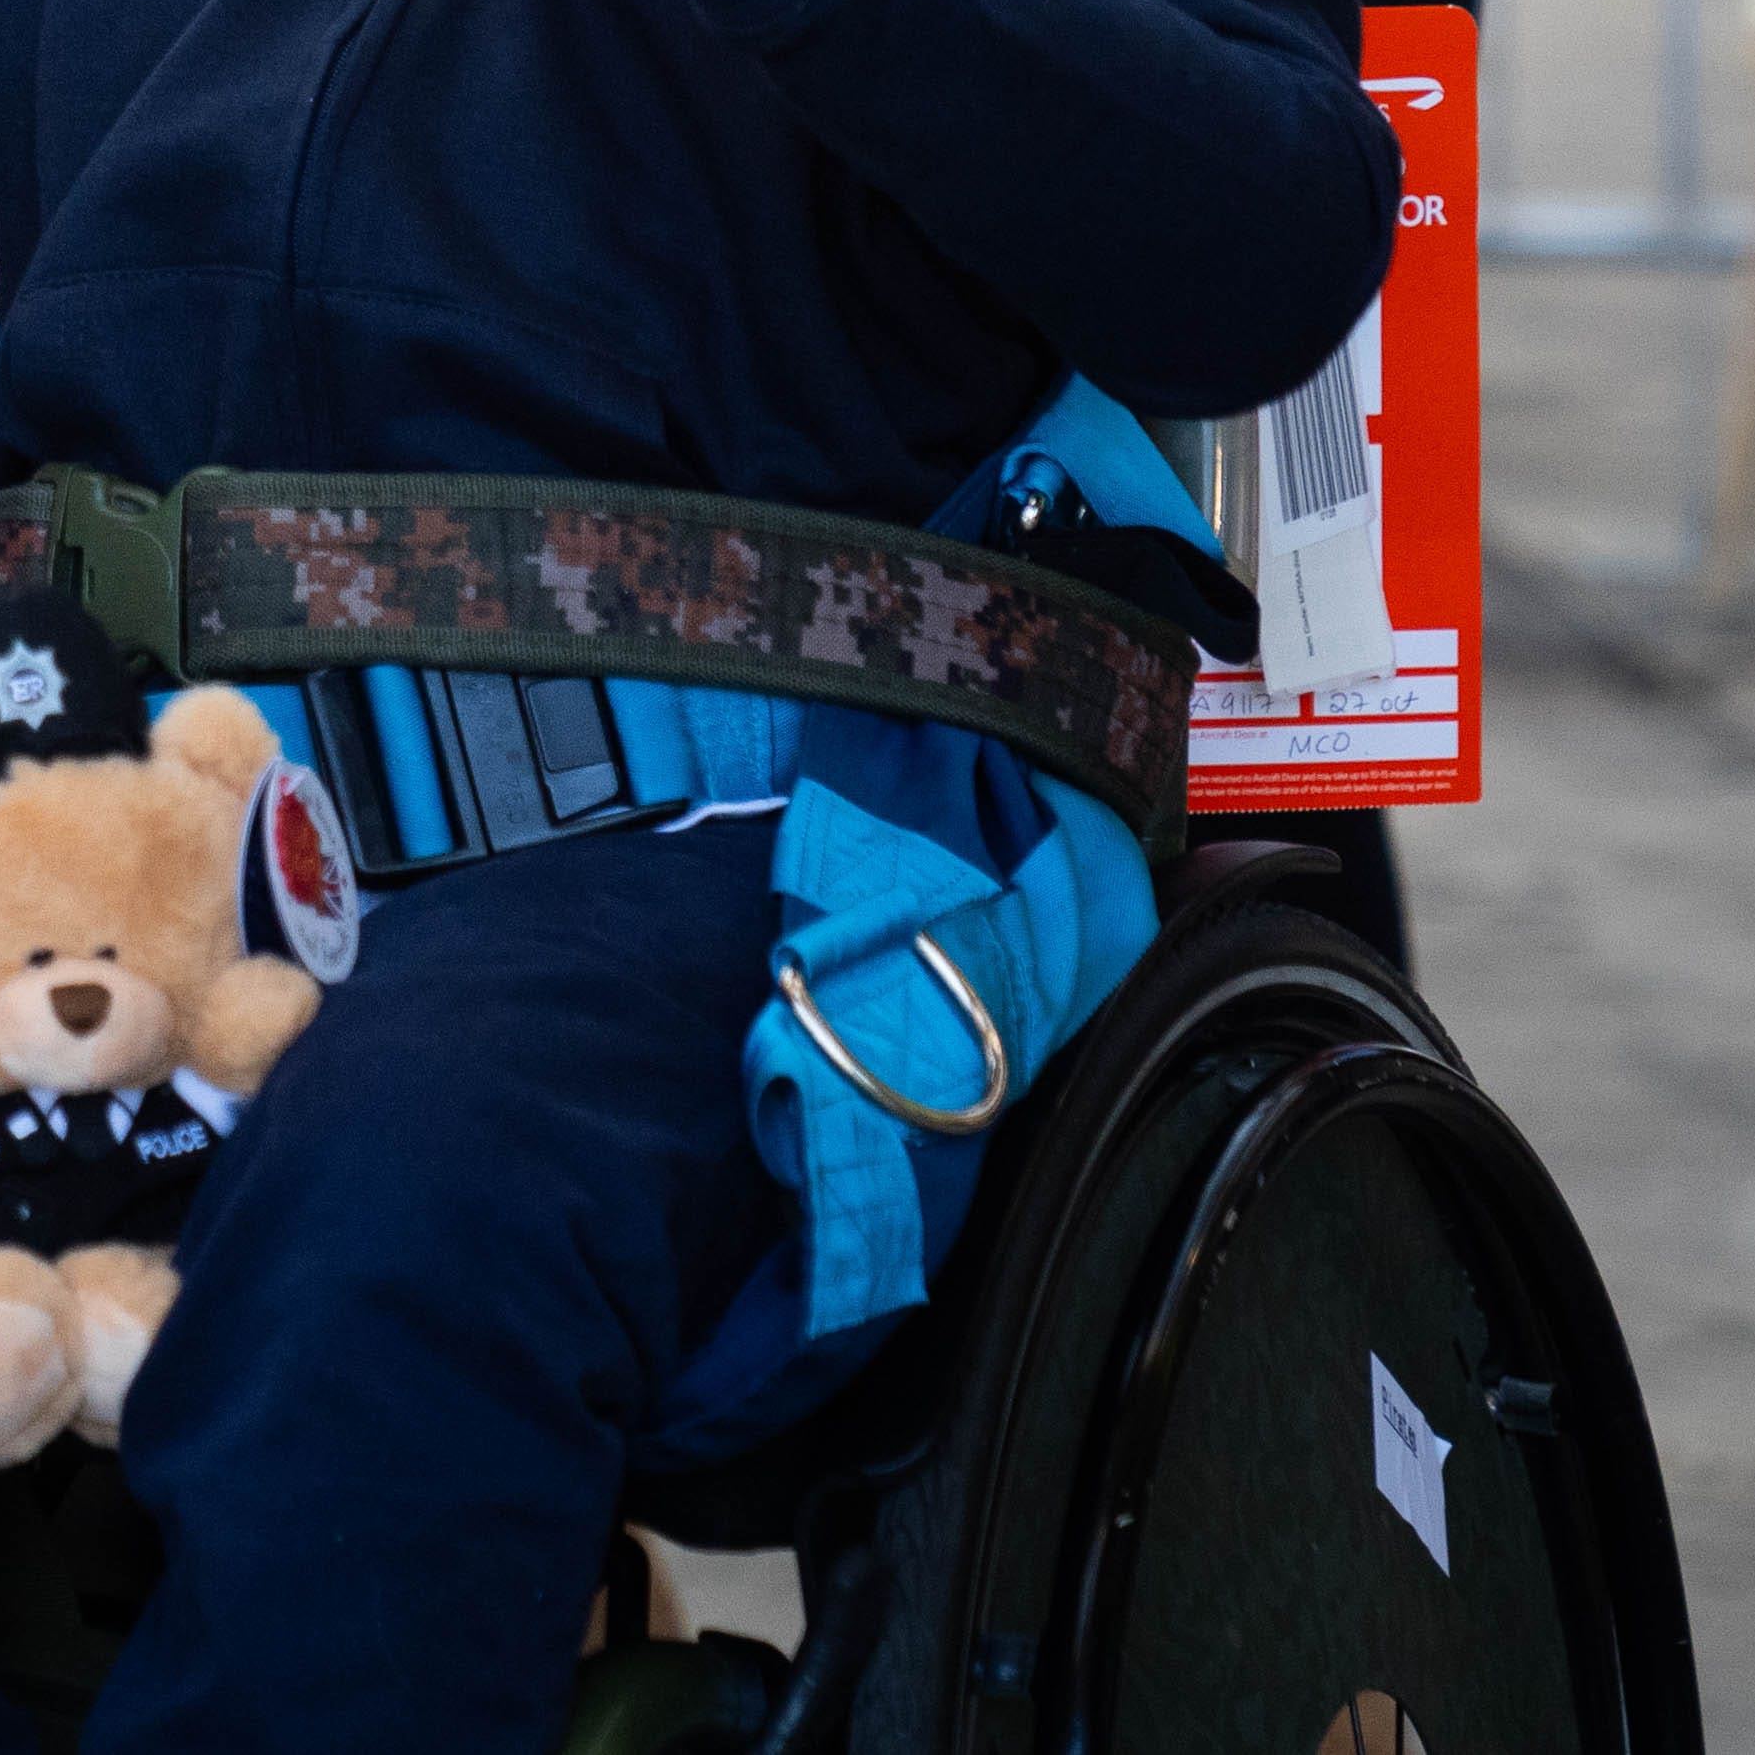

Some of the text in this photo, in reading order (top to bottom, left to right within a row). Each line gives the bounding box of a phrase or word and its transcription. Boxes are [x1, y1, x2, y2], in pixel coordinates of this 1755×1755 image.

[1329, 694, 1370, 715] 27
[1288, 731, 1352, 759] MCO
[134, 1121, 209, 1164] POLICE
